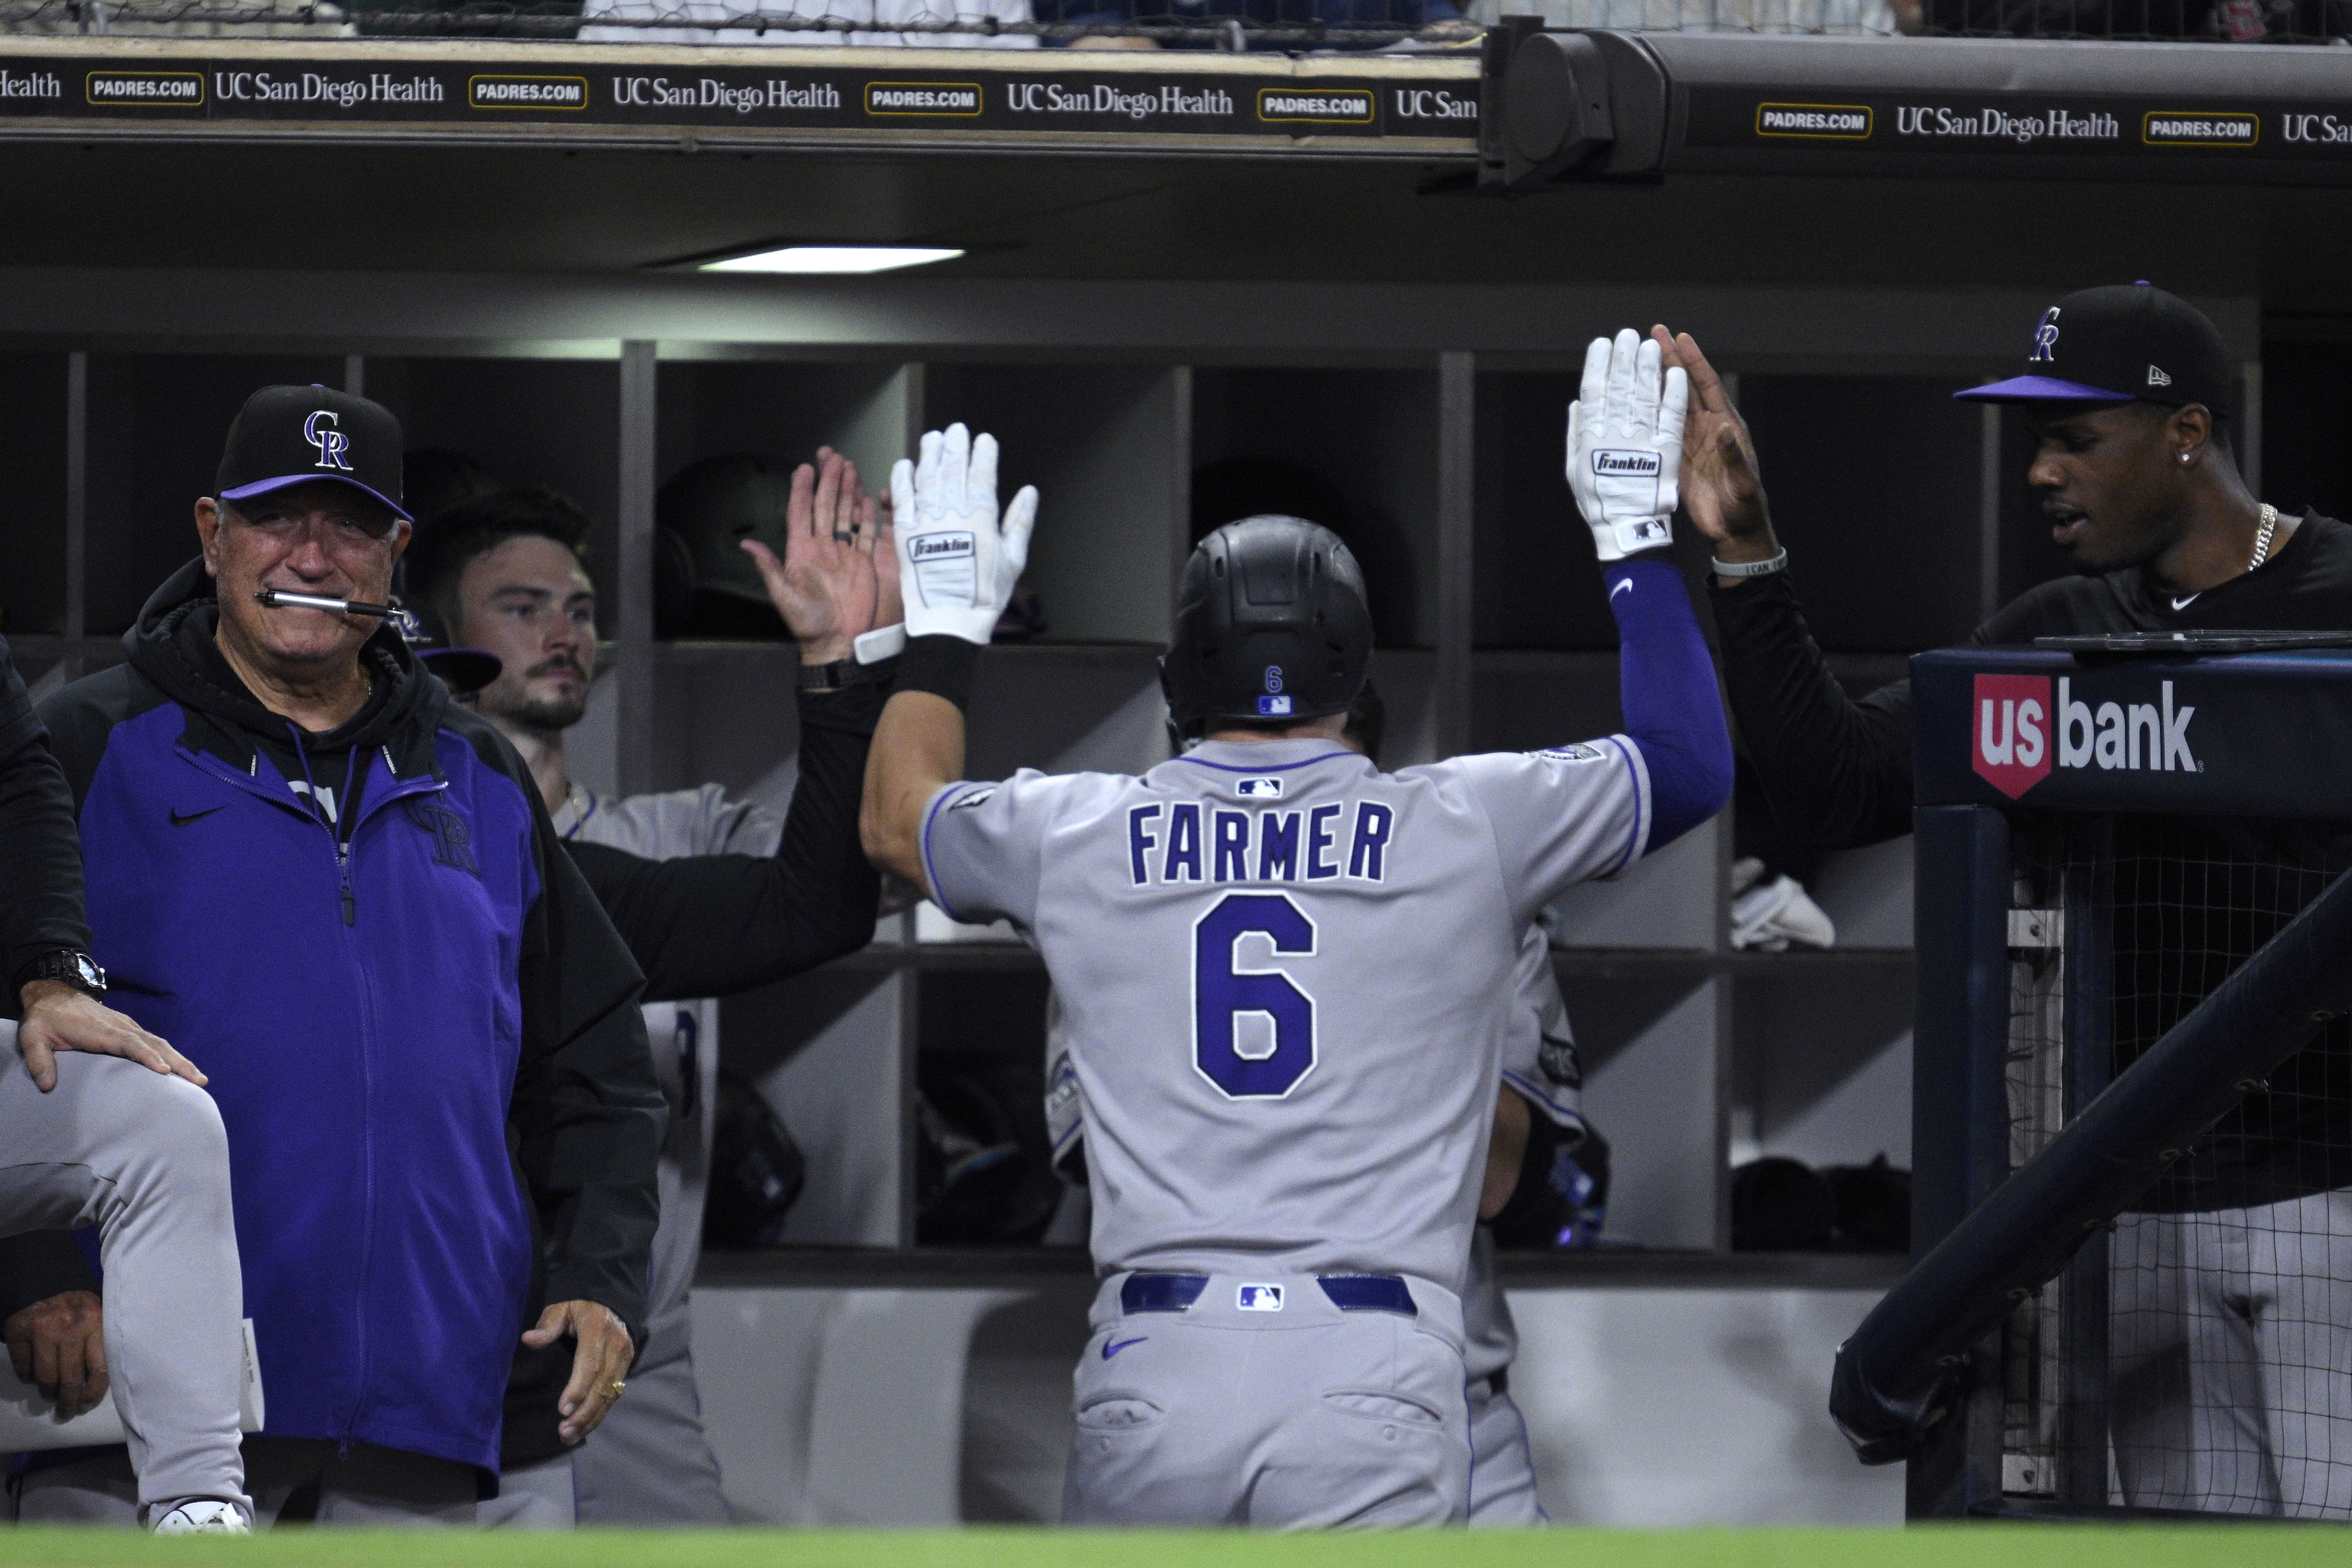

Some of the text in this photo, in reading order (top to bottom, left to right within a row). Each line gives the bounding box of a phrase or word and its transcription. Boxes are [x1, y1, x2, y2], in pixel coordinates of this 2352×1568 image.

[95, 81, 196, 96] PADRES.COM
[215, 73, 443, 107] UC San Diego Health
[477, 84, 580, 101] PADRES.COM
[613, 77, 840, 113] UC San Diego Health
[872, 91, 975, 107] PADRES.COM
[1007, 83, 1234, 119] UC San Diego Health
[1264, 97, 1367, 114] PADRES.COM
[1396, 90, 1477, 118] UC San
[1764, 112, 1865, 129] PADRES.COM
[1898, 107, 2118, 141] UC San Diego Health
[2151, 121, 2251, 137] PADRES.COM
[2284, 115, 2352, 142] UC Sa
[304, 410, 353, 470] CR
[1597, 452, 1657, 471] Franklin
[913, 536, 970, 557] Franklin
[1265, 665, 1283, 693] 6
[1981, 677, 2198, 772] us bank
[1126, 799, 1395, 888] FARMER
[1192, 889, 1318, 1101] 6
